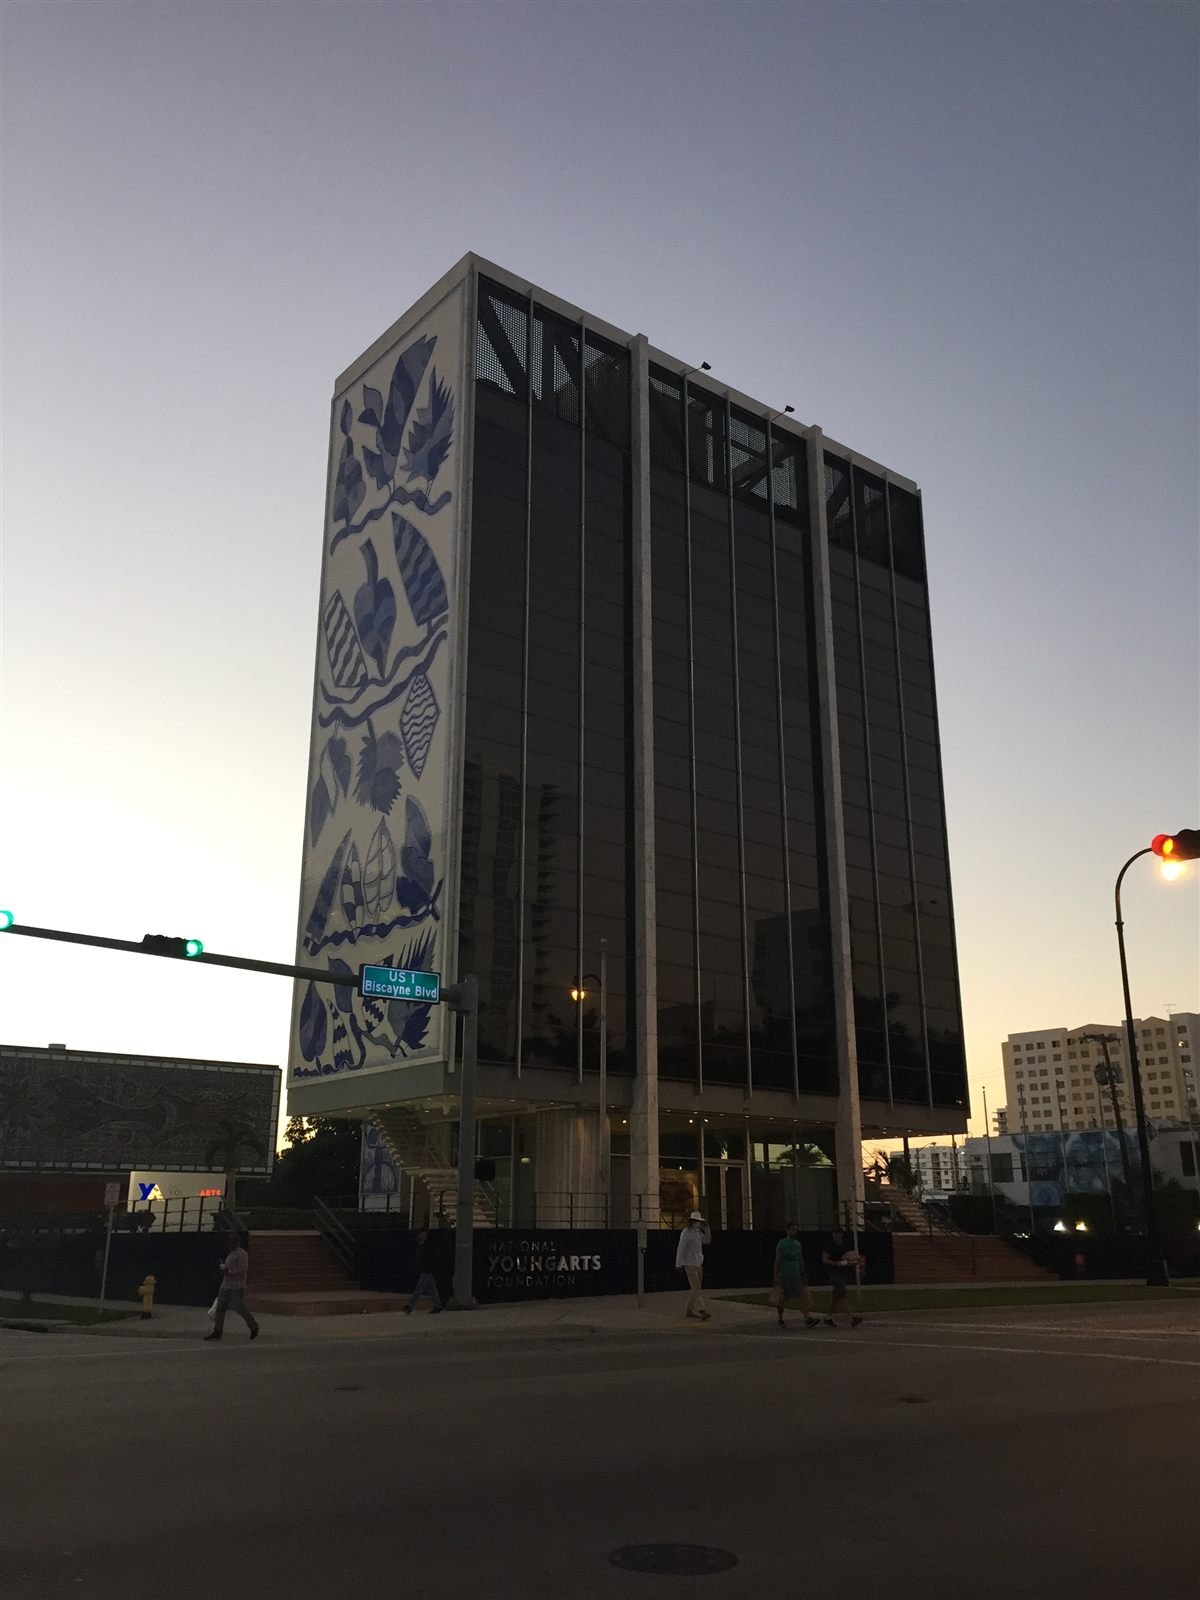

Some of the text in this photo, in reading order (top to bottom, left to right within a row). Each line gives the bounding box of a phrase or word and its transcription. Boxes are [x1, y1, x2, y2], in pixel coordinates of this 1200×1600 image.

[389, 970, 415, 984] US 1
[365, 980, 437, 998] Biscayne Blvd
[488, 1240, 558, 1252] NATONAL
[487, 1254, 602, 1272] YOUNGARTS
[487, 1274, 576, 1288] FOUNDATION
